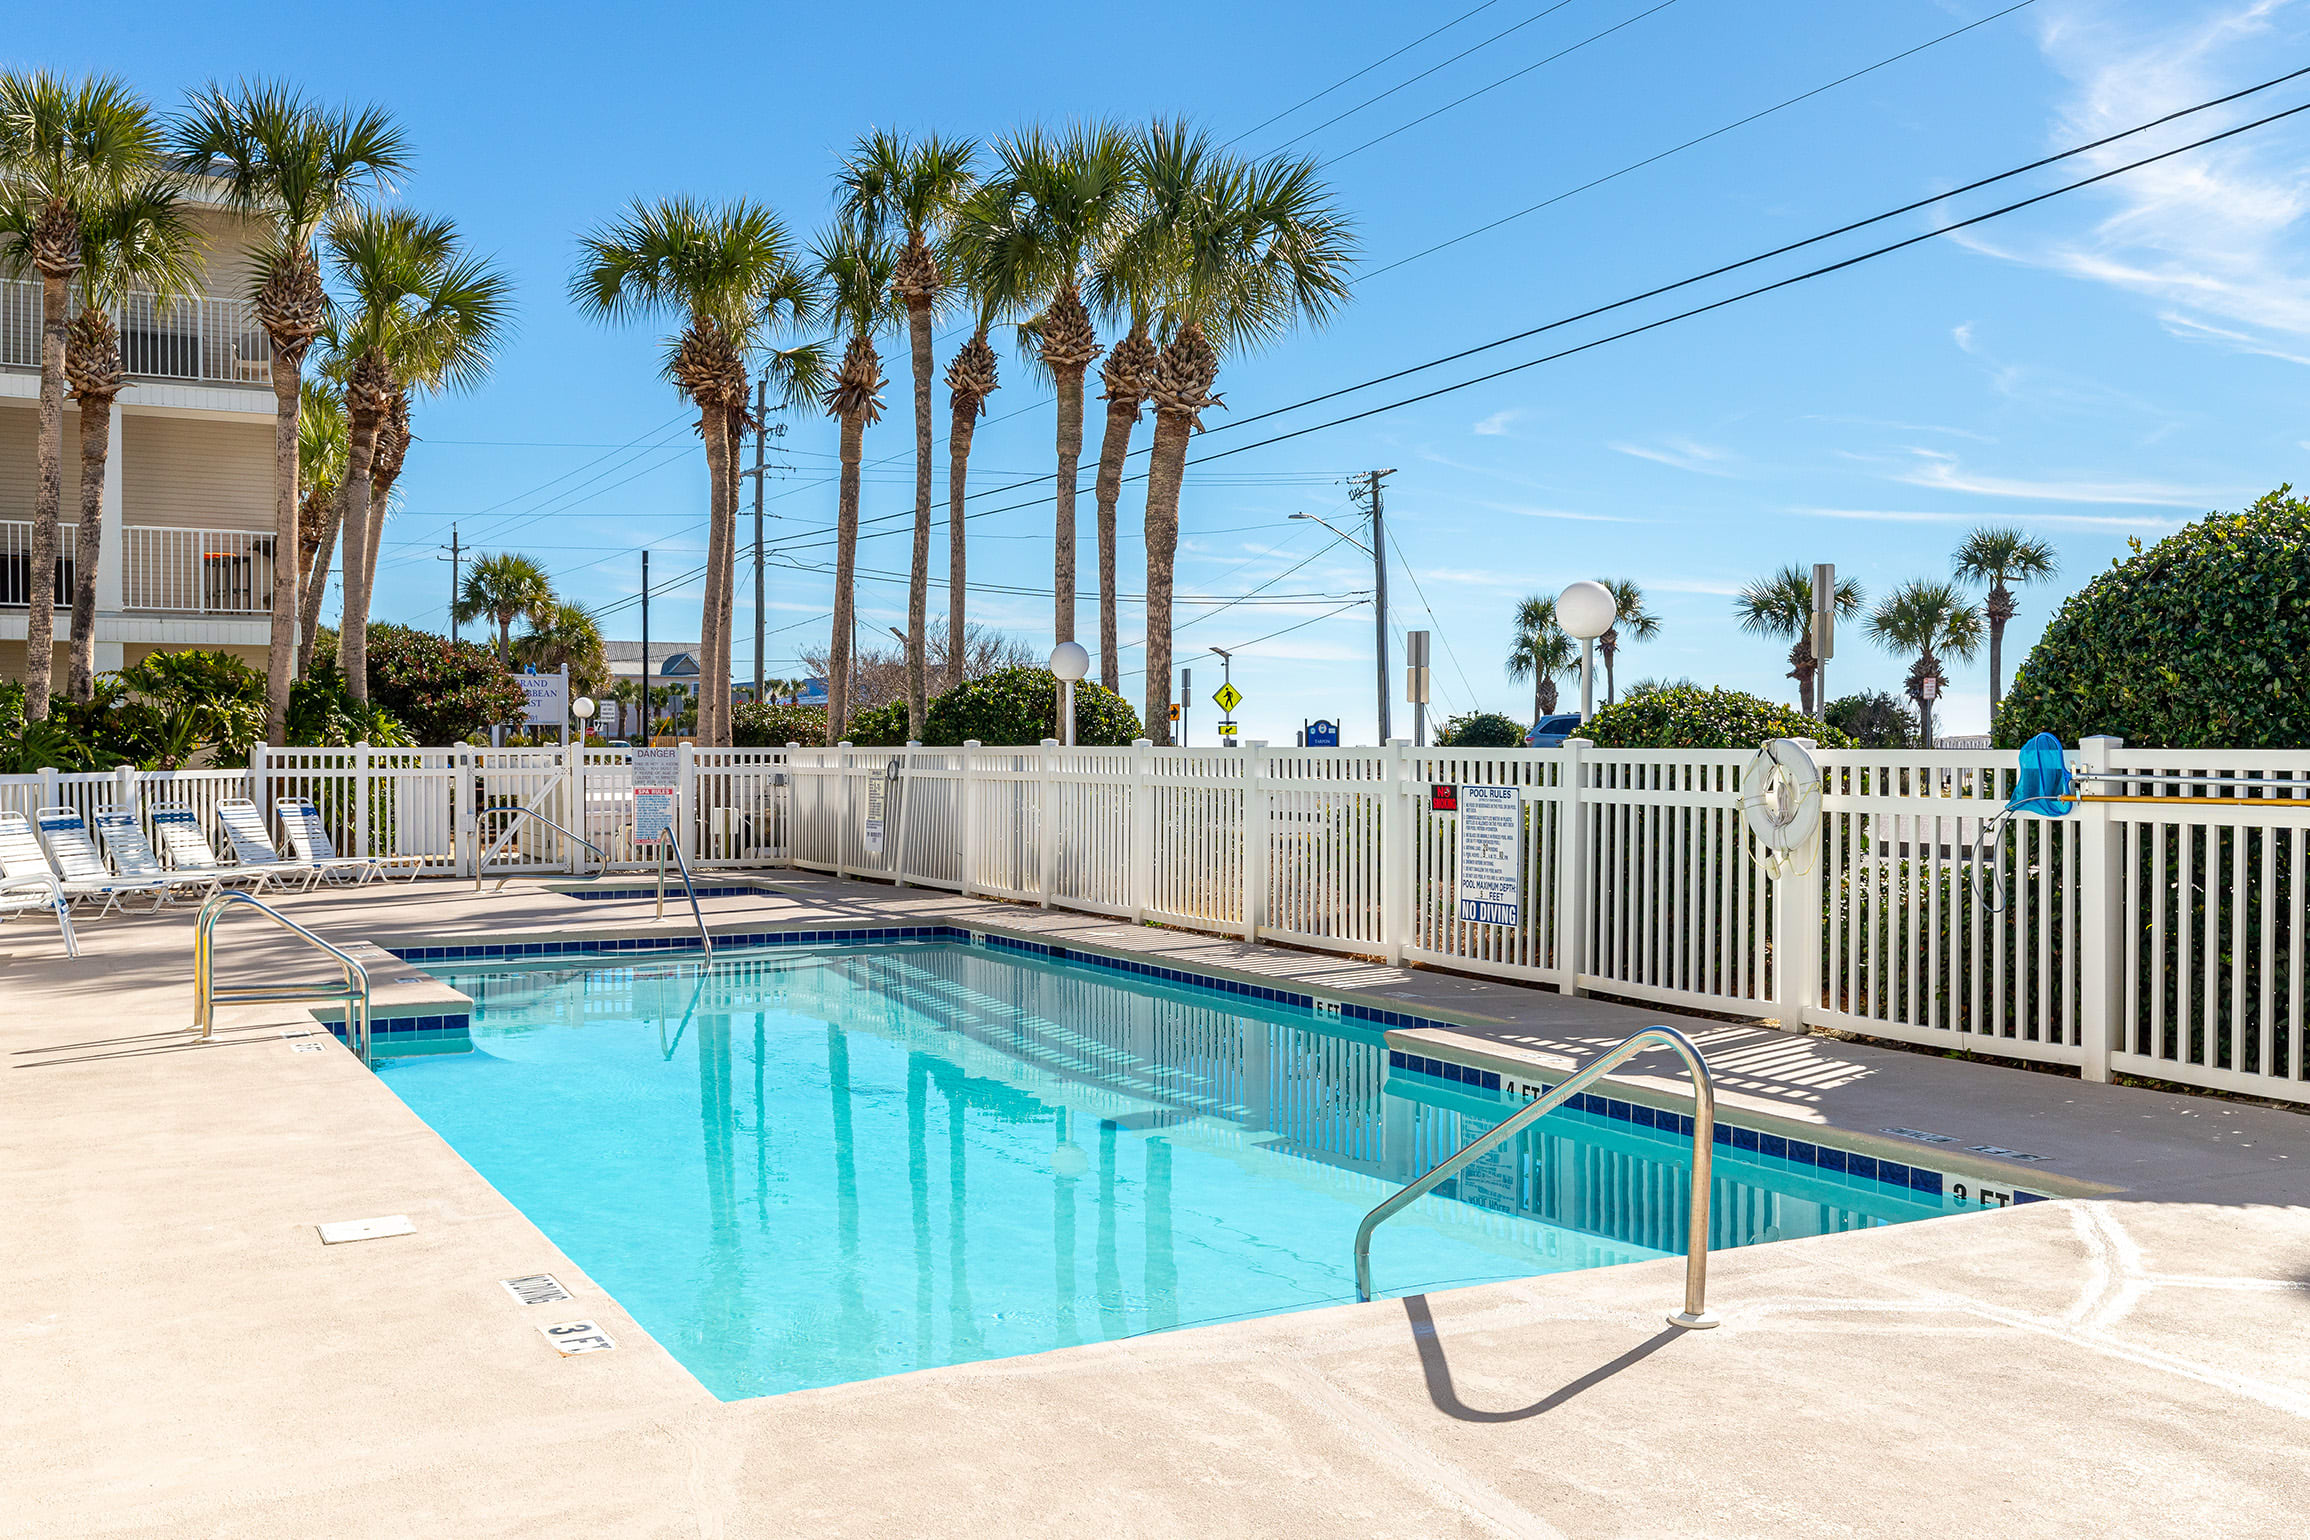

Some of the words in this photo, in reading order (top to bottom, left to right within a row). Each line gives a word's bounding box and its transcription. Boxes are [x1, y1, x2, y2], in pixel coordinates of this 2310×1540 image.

[519, 679, 548, 688] RAND
[637, 749, 676, 758] DANGER
[1437, 786, 1451, 798] NO
[1469, 788, 1488, 798] POOL
[1489, 789, 1512, 799] RULES
[1463, 879, 1476, 889] POOL
[1477, 880, 1499, 891] MAXIMUM
[1489, 891, 1504, 901] FEET
[1461, 900, 1477, 920] NO
[1479, 902, 1517, 925] DIVING
[1522, 1084, 1540, 1100] FT
[1980, 1188, 2010, 1208] FT
[548, 1324, 592, 1335] 3
[560, 1335, 612, 1352] FT
